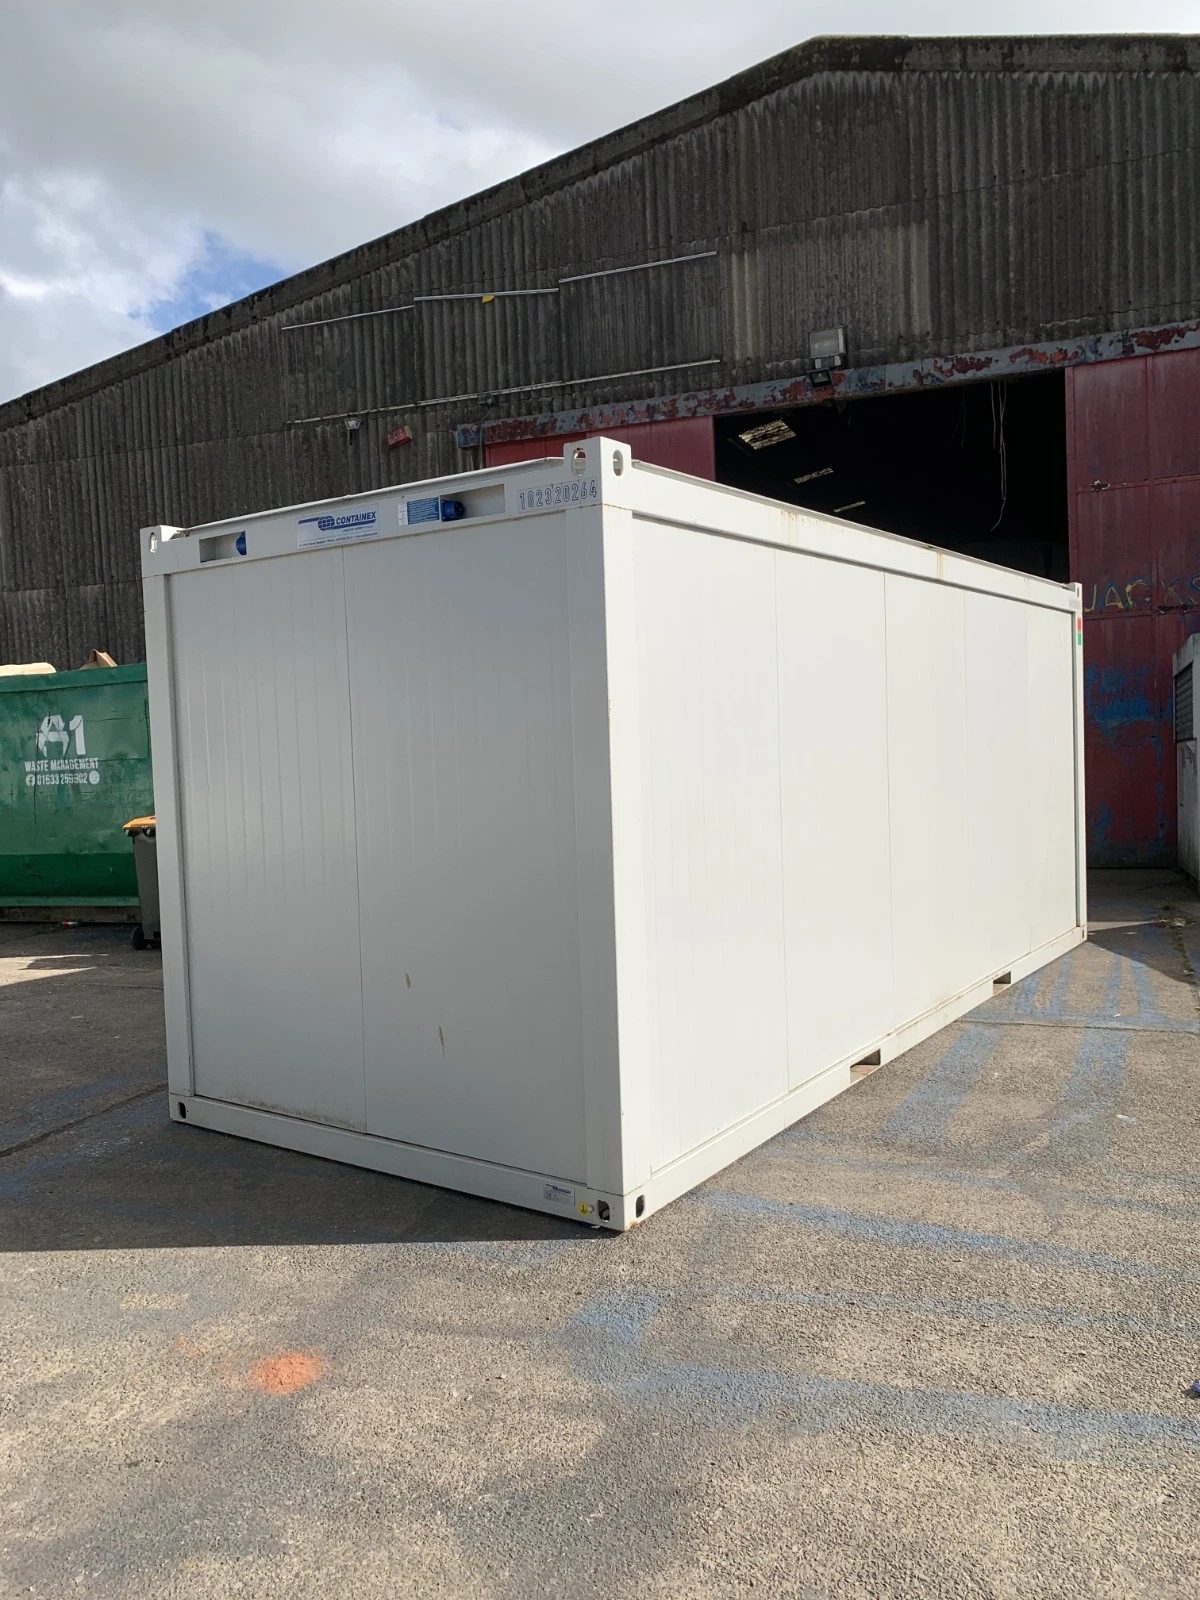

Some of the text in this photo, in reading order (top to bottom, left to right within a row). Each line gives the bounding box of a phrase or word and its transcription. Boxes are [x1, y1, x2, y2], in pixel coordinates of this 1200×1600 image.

[335, 510, 377, 526] CONTAINEX
[35, 714, 86, 758] A1
[24, 757, 99, 773] WASTE MANAGEMENT
